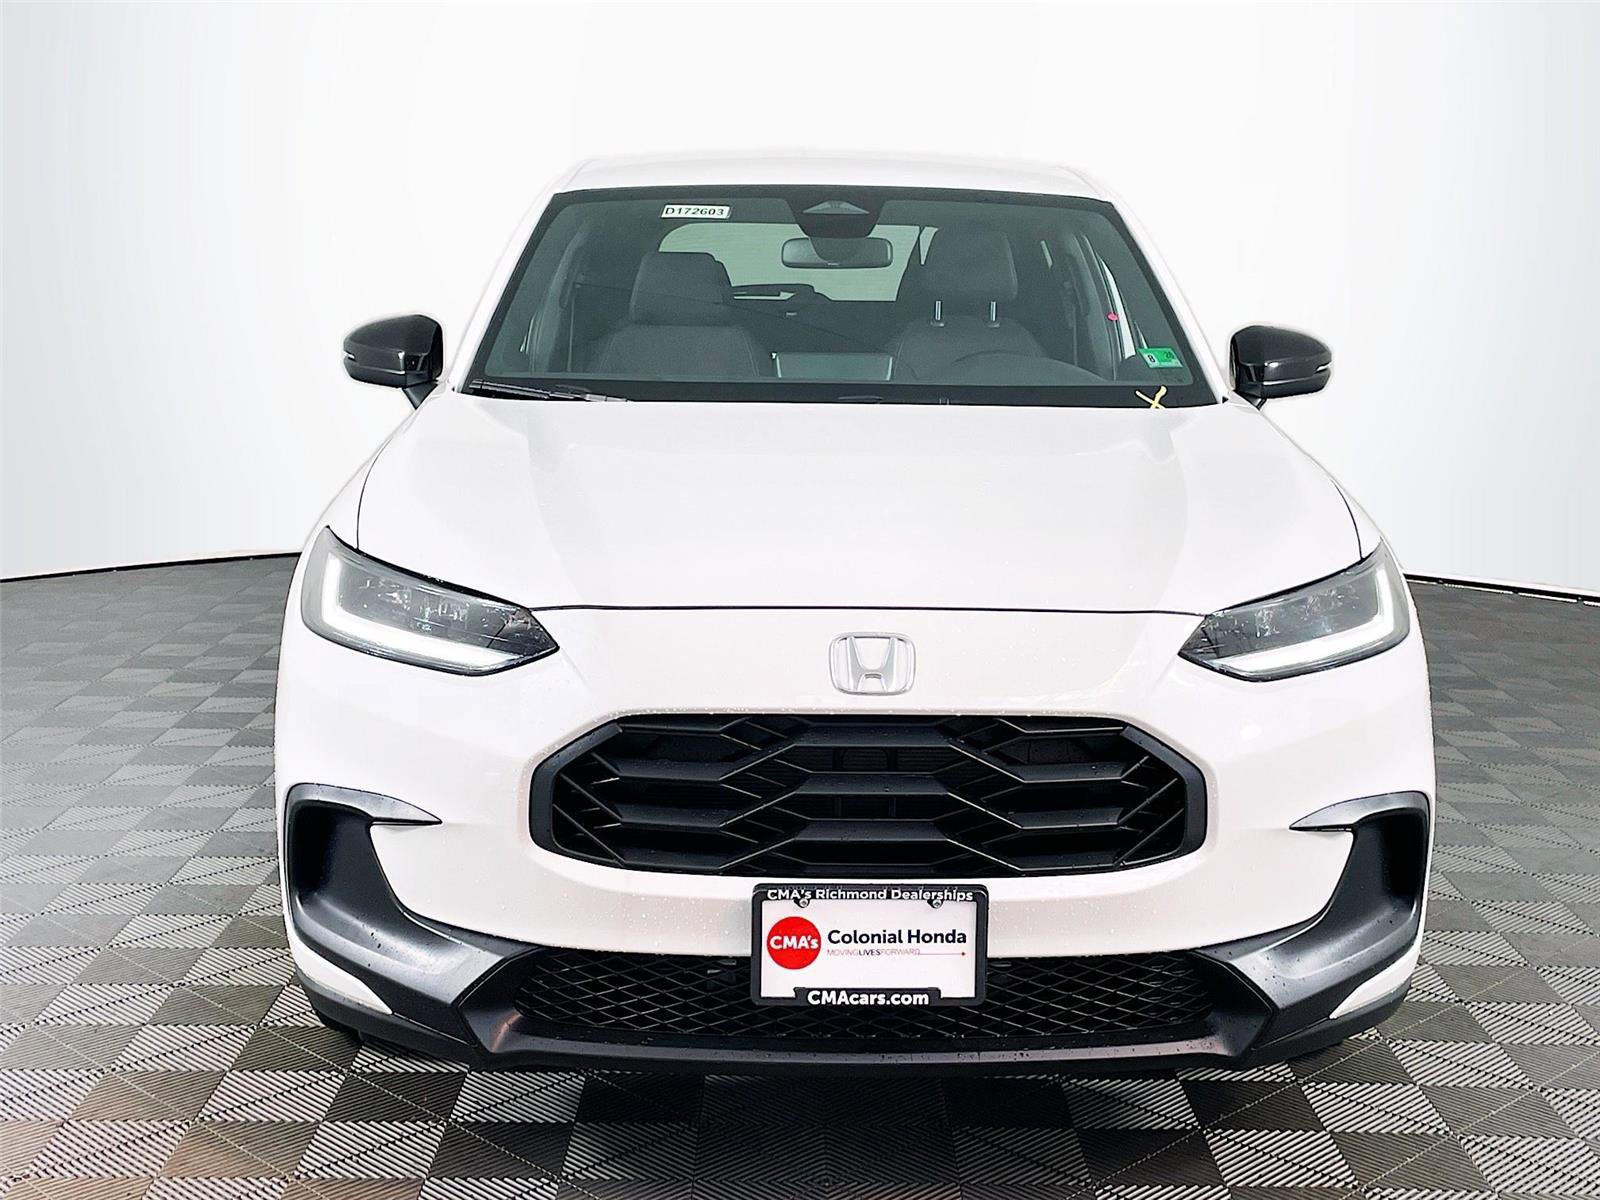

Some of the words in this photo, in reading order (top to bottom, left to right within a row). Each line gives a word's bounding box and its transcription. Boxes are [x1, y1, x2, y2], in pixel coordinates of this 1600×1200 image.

[665, 207, 724, 216] D172603
[767, 889, 812, 900] CMA's
[815, 889, 887, 900] Richmond
[891, 889, 974, 903] Dealerships
[769, 934, 819, 950] CMA's
[827, 929, 903, 944] Colonial
[907, 929, 967, 944] Honda
[807, 990, 930, 1006] CMAcars.com
